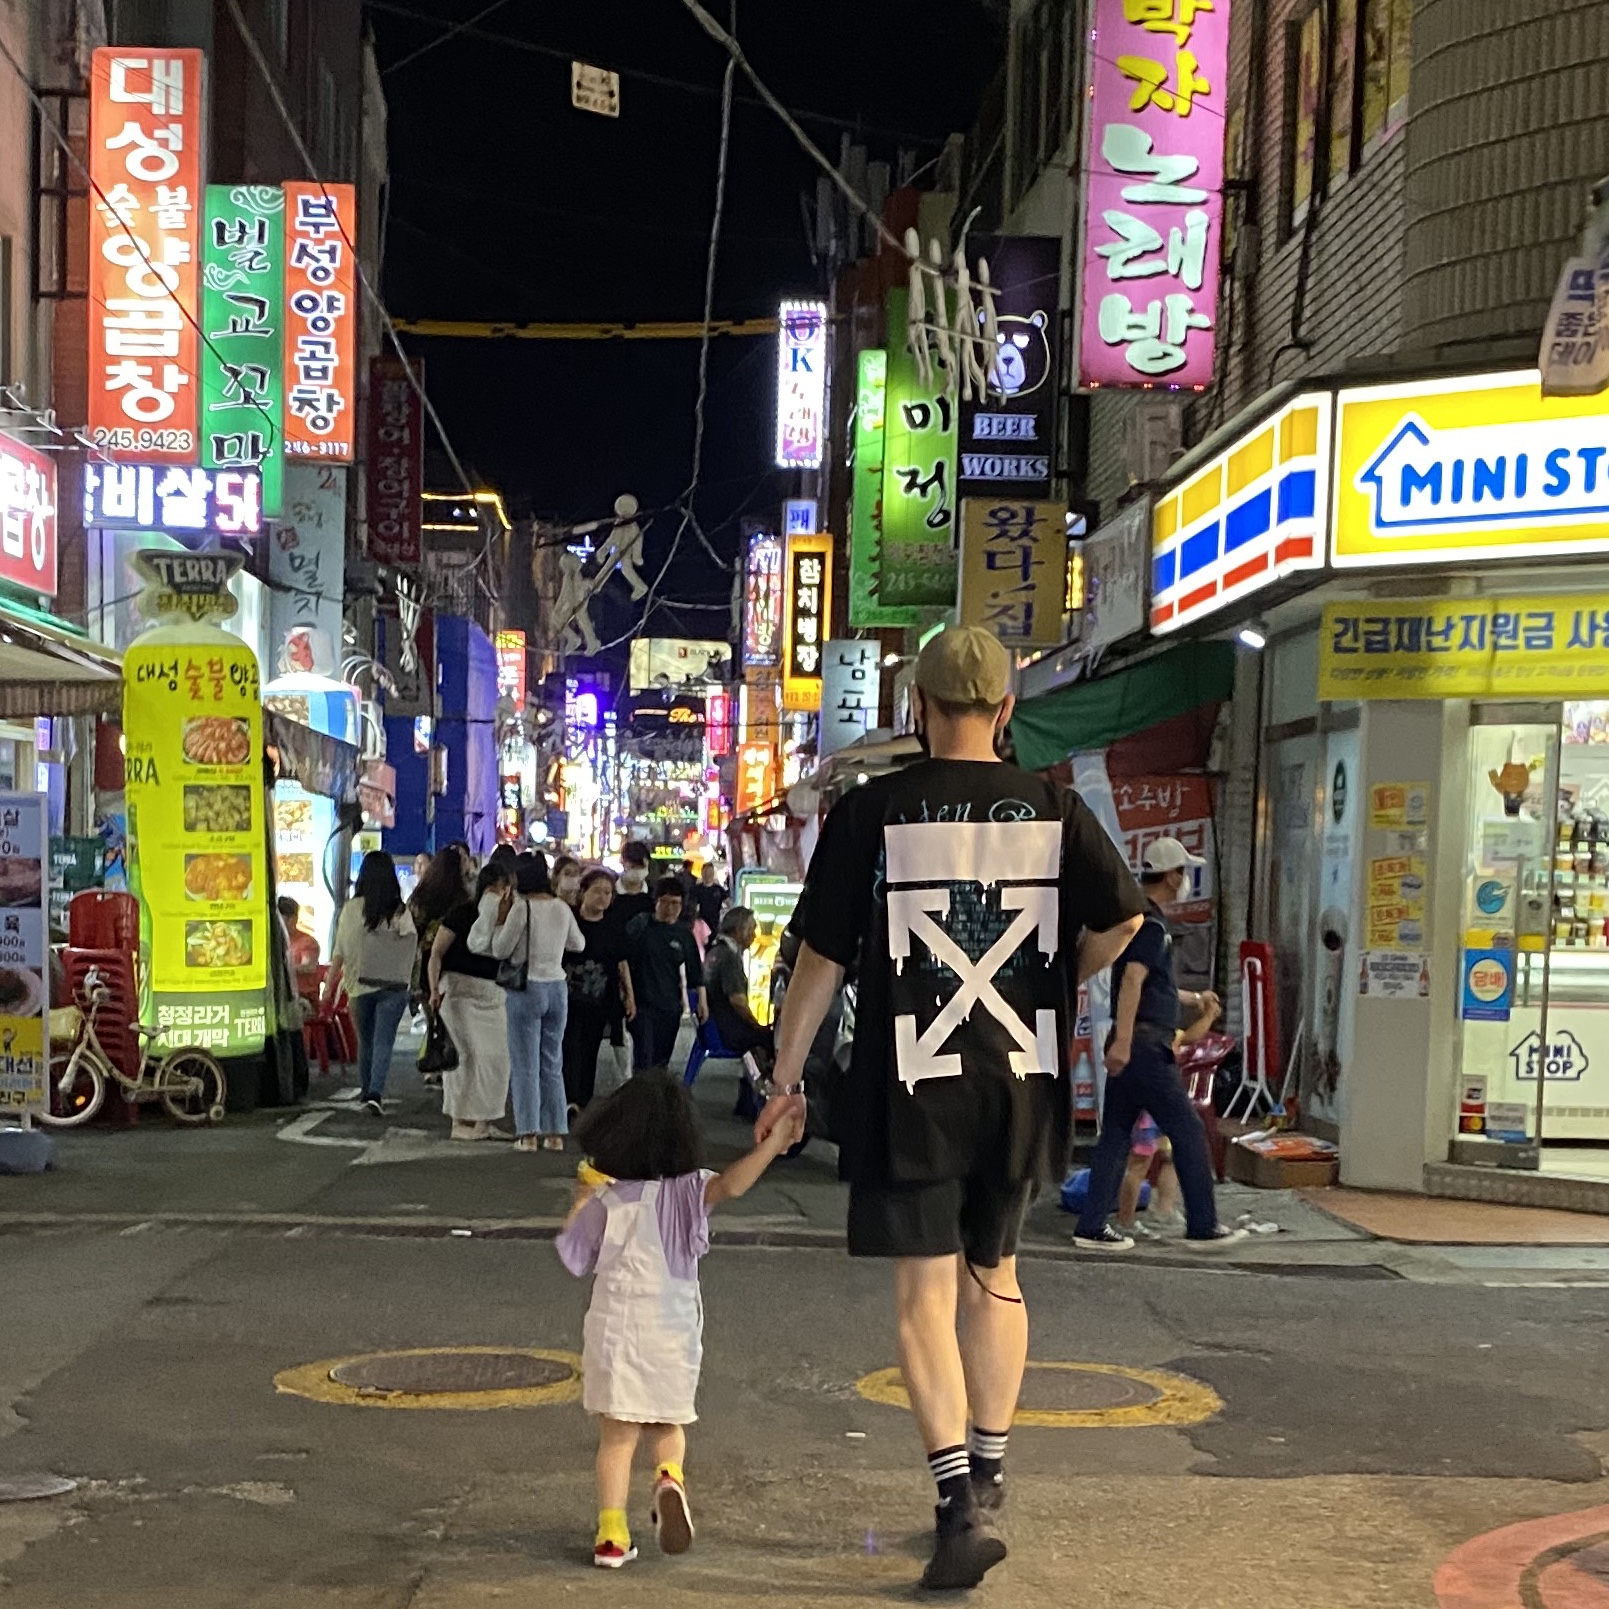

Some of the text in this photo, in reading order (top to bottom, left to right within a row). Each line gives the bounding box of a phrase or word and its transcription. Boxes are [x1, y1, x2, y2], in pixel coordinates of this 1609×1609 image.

[1096, 124, 1212, 373] 노래방
[289, 194, 346, 435] 부성양곱창
[209, 217, 273, 470] 벌교꼬막
[973, 416, 1036, 438] BEER
[95, 430, 192, 450] 245.9423
[284, 441, 349, 456] 246-3117
[961, 456, 1049, 478] WORKS
[1400, 446, 1609, 508] MINI ST
[153, 558, 229, 585] TERRA
[1333, 610, 1609, 655] 긴급재난지원금 사
[1473, 971, 1505, 988] 담배
[1526, 1060, 1574, 1075] SOP
